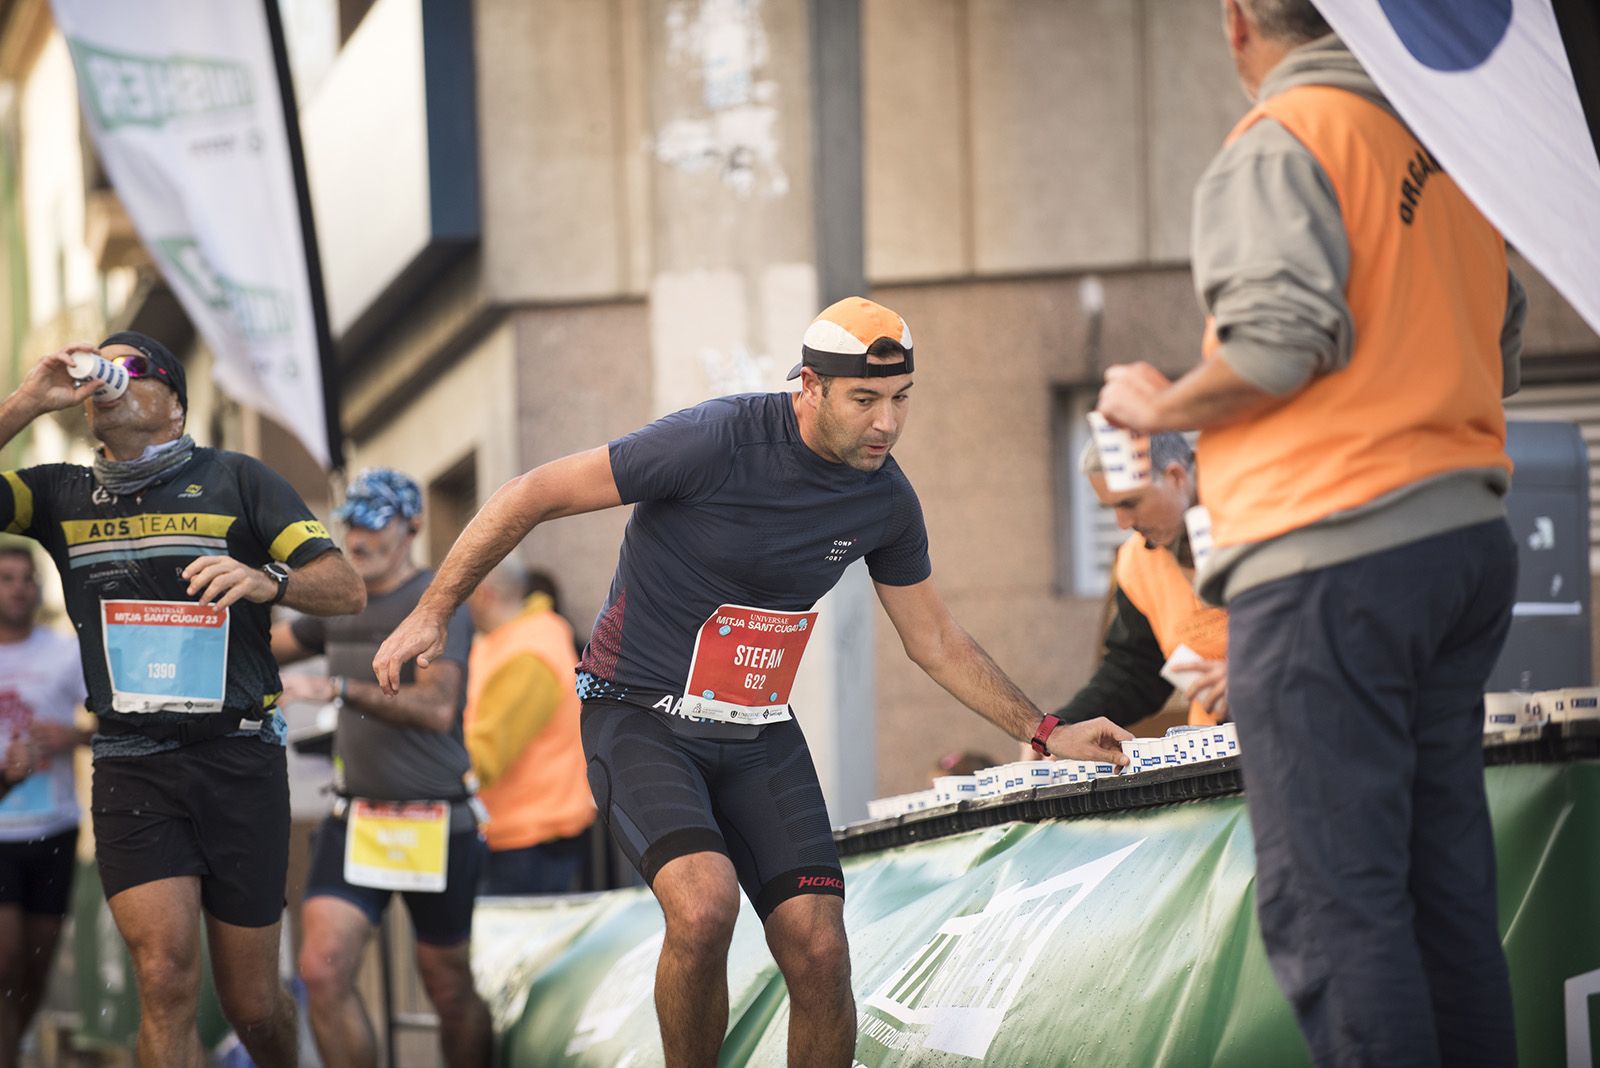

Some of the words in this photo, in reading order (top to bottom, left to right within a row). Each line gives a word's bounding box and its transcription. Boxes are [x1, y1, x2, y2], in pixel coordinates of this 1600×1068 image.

[88, 521, 130, 538] AOS
[139, 516, 198, 534] TEAM
[144, 613, 171, 622] SANT
[171, 614, 205, 623] CUGAT
[205, 615, 218, 624] 23
[716, 616, 745, 628] MITJA
[748, 621, 774, 632] SANT
[750, 614, 789, 624] UNIVERSAE
[734, 644, 785, 669] STEFAN
[147, 663, 176, 679] 1390
[744, 672, 767, 690] 622
